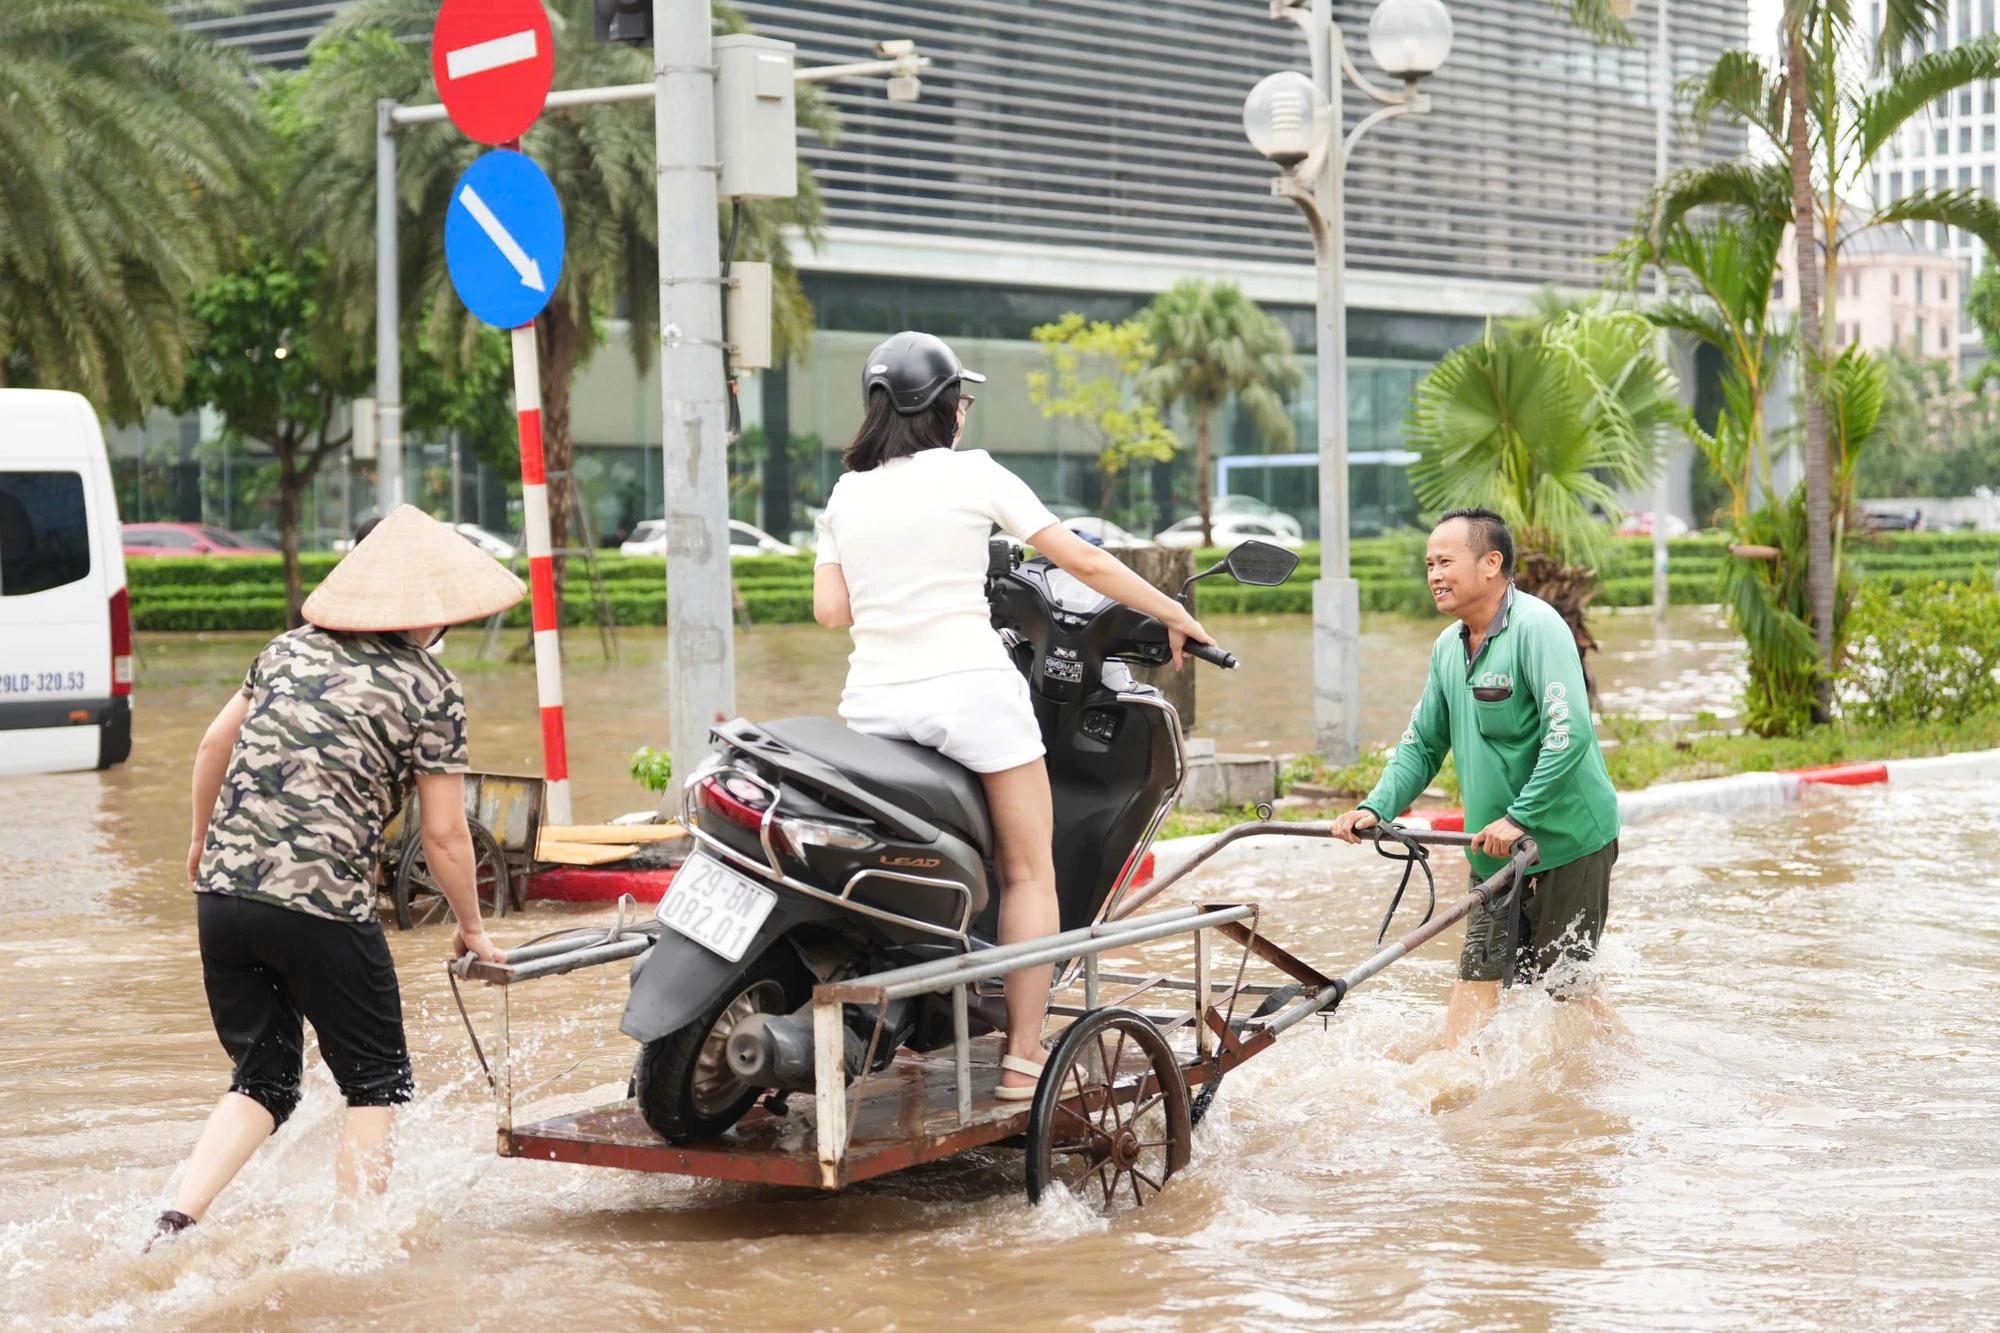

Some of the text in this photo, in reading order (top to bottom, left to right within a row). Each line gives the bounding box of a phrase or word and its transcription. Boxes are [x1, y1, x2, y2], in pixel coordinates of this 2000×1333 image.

[0, 671, 85, 693] 9LD-320.53
[1544, 682, 1570, 751] Grab
[880, 855, 940, 868] LEAD
[688, 863, 762, 919] 29-BN
[664, 890, 748, 953] 082.01
